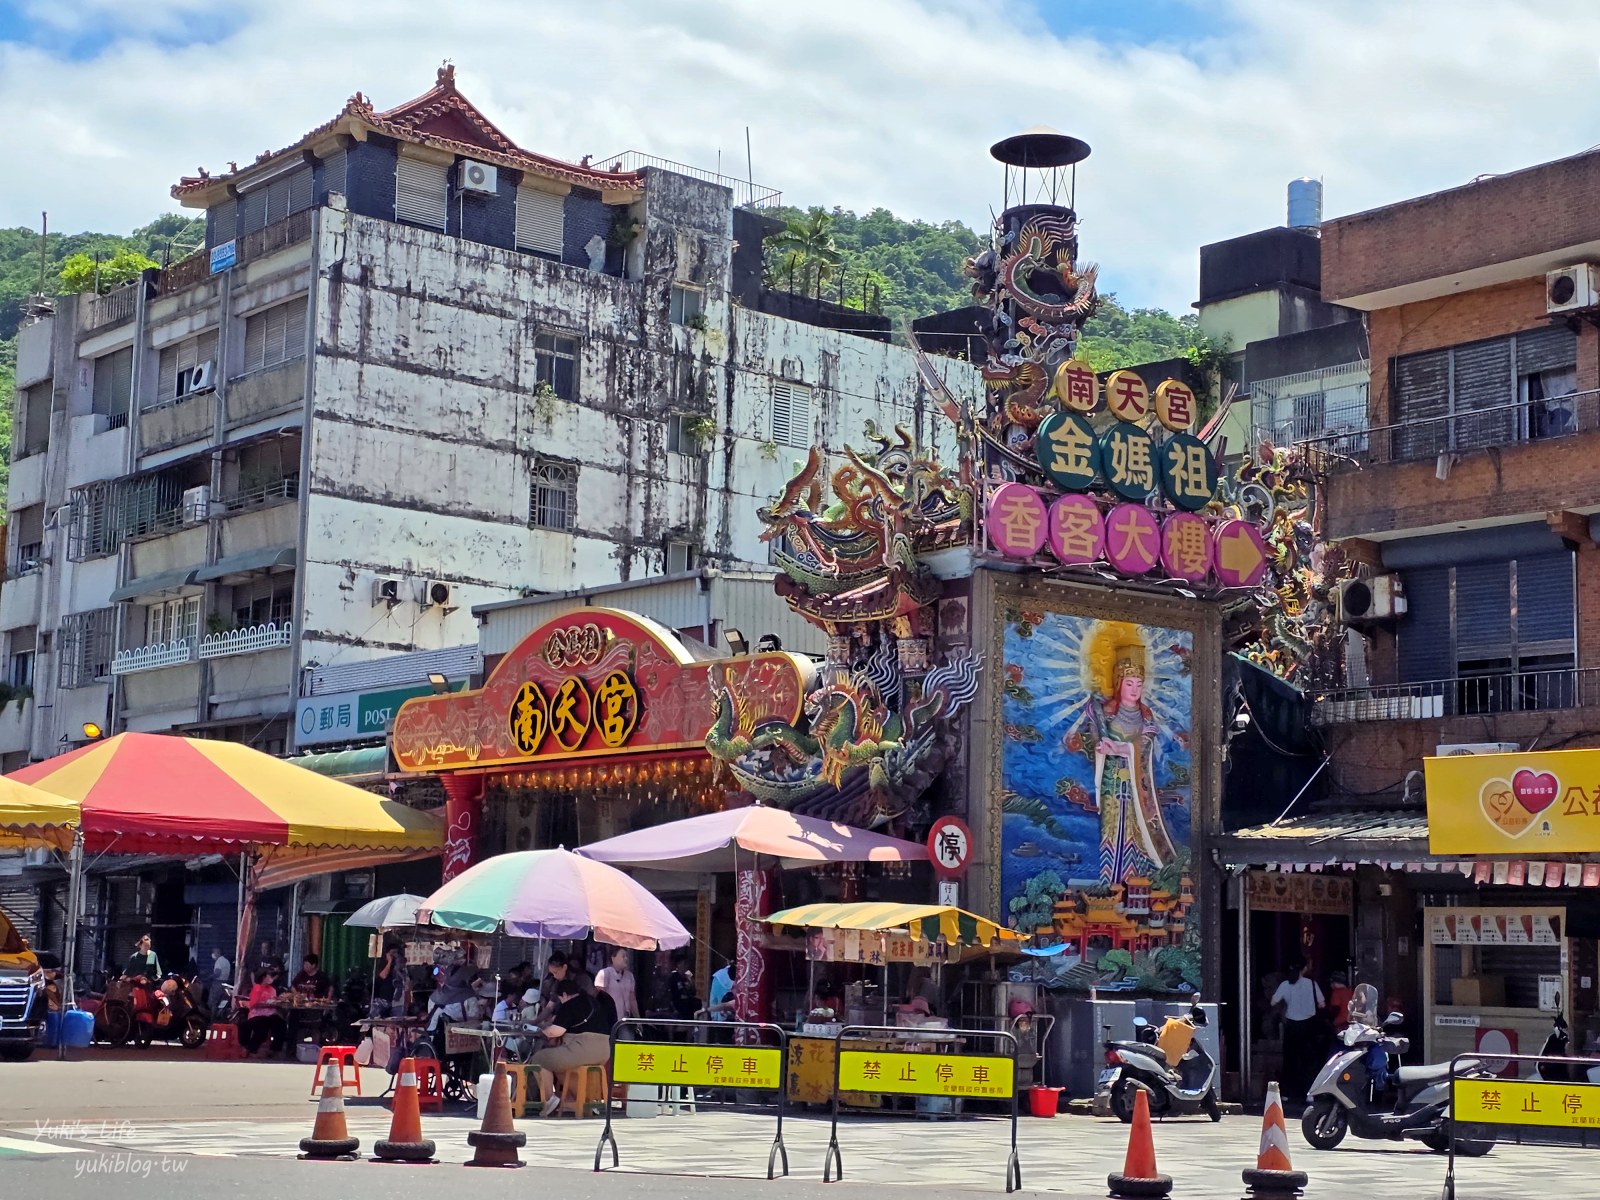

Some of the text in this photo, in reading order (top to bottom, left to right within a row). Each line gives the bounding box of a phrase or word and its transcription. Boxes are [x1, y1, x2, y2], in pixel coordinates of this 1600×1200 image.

[1066, 367, 1192, 425] 南天宮
[1048, 417, 1212, 499] 金媽祖
[1000, 493, 1207, 575] 香客大樓
[319, 703, 351, 731] 郵局
[364, 707, 392, 726] POST
[514, 676, 634, 750] 南天宮
[939, 832, 961, 861] 停
[944, 884, 953, 906] 行人
[637, 1052, 759, 1076] 禁止停車
[863, 1059, 990, 1085] 禁止停車
[1481, 1089, 1583, 1114] 禁止停
